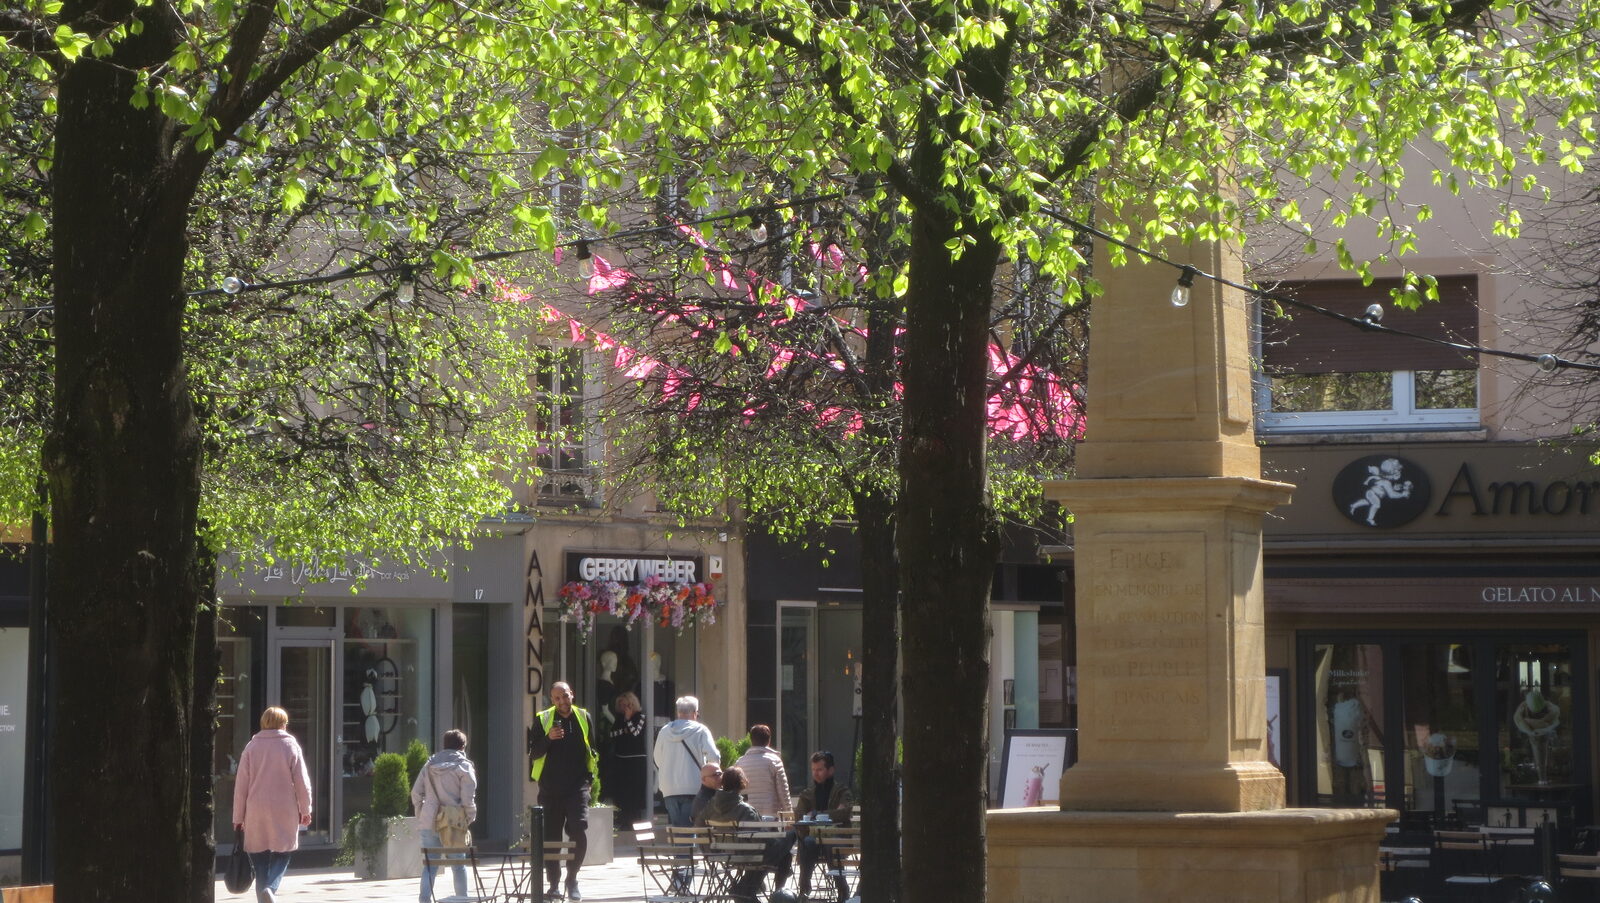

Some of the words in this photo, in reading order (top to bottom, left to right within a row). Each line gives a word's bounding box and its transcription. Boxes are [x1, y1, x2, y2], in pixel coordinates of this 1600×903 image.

[329, 551, 375, 583] Lunttes
[579, 557, 638, 581] GERRY
[637, 559, 696, 583] WEBER
[475, 589, 484, 600] 17
[1482, 587, 1556, 602] GELATO
[1561, 587, 1586, 602] AL
[525, 549, 544, 782] AMANDI
